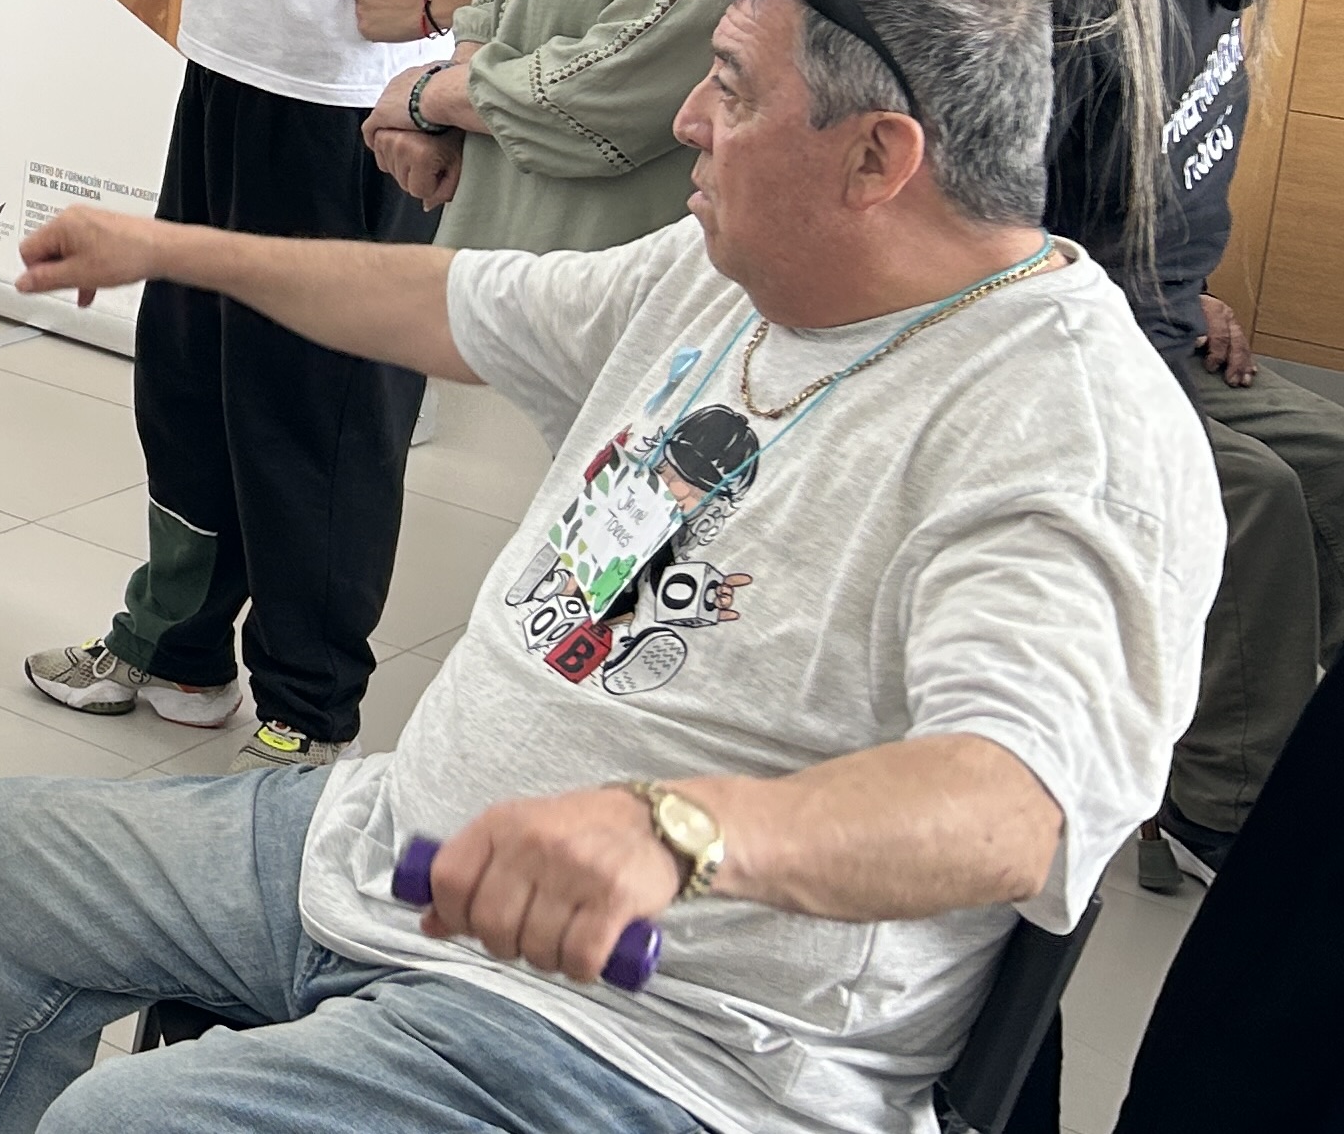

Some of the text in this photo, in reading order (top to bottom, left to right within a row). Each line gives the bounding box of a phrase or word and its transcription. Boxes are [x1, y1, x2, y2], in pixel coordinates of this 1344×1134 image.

[50, 179, 59, 190] DE
[60, 182, 101, 201] EXCELENCIA
[555, 634, 595, 673] B
